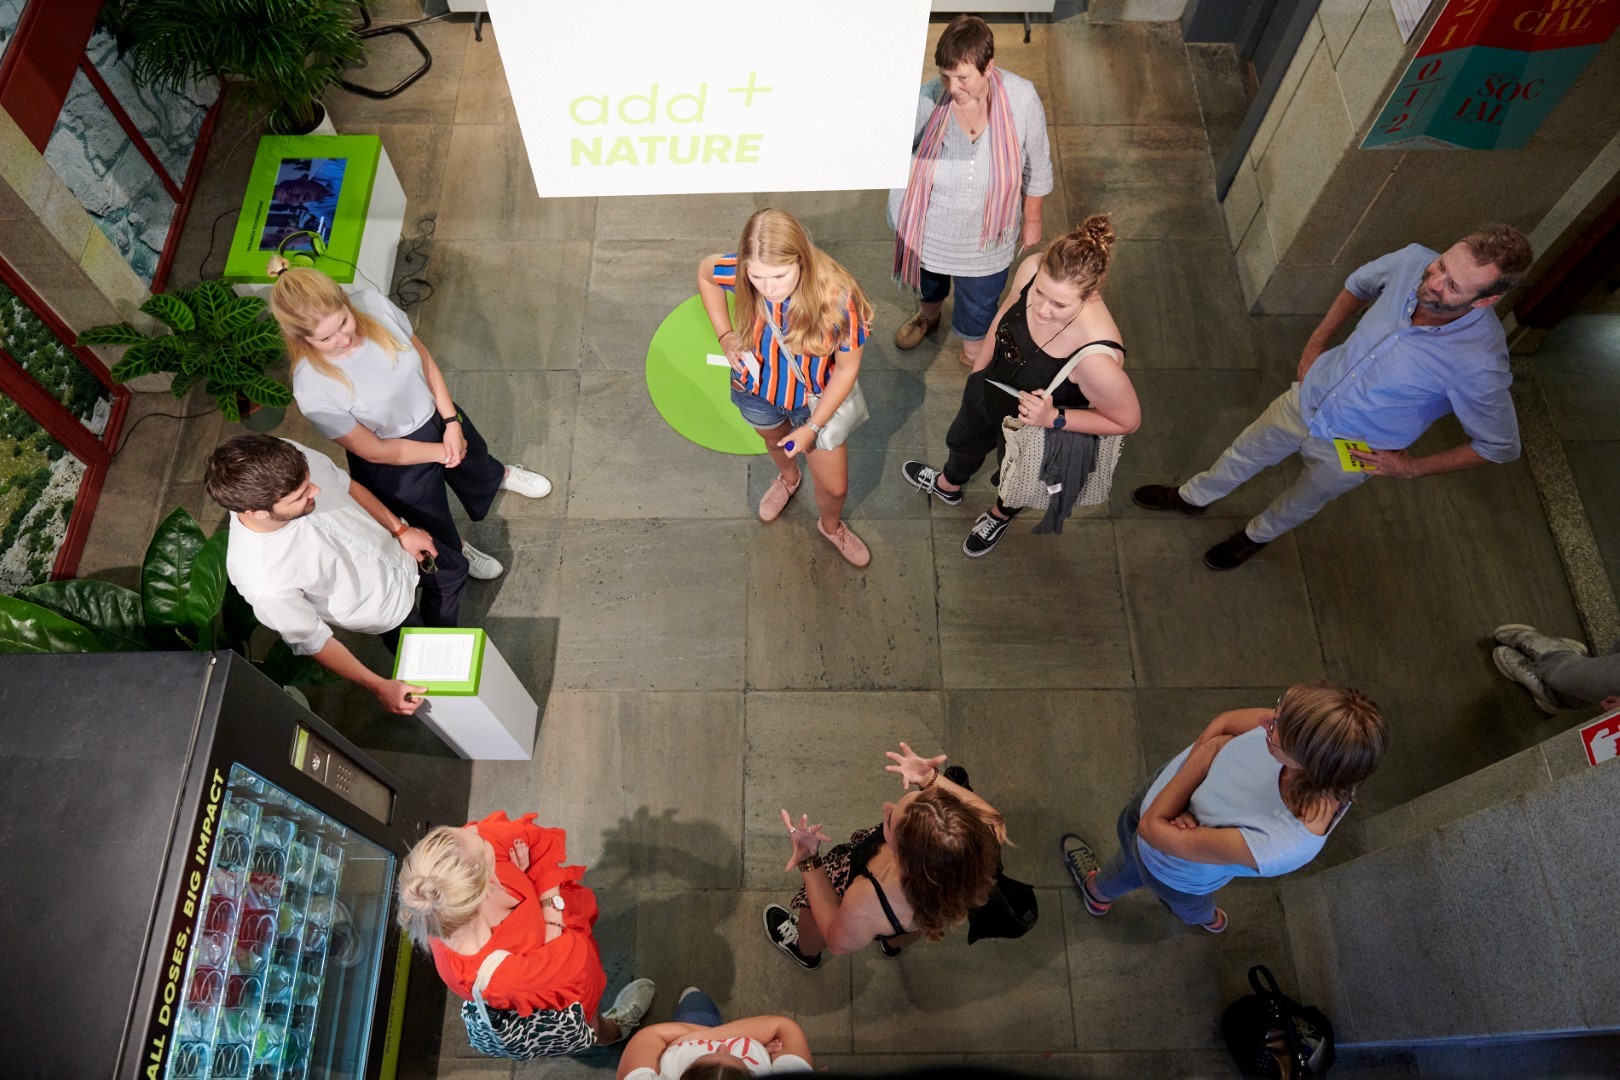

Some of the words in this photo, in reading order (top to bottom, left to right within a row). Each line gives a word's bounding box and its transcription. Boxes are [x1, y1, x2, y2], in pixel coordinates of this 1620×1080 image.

[1438, 24, 1459, 47] 1
[1513, 6, 1592, 36] CIAL
[1417, 58, 1442, 81] 0
[1478, 75, 1544, 101] SOC
[569, 82, 708, 125] add
[1457, 97, 1504, 125] IAL
[571, 134, 764, 167] NATURE
[146, 1034, 166, 1080] ALL
[158, 926, 191, 1027] DOSES,
[183, 871, 201, 918] BIG
[195, 768, 224, 866] IMPACT
